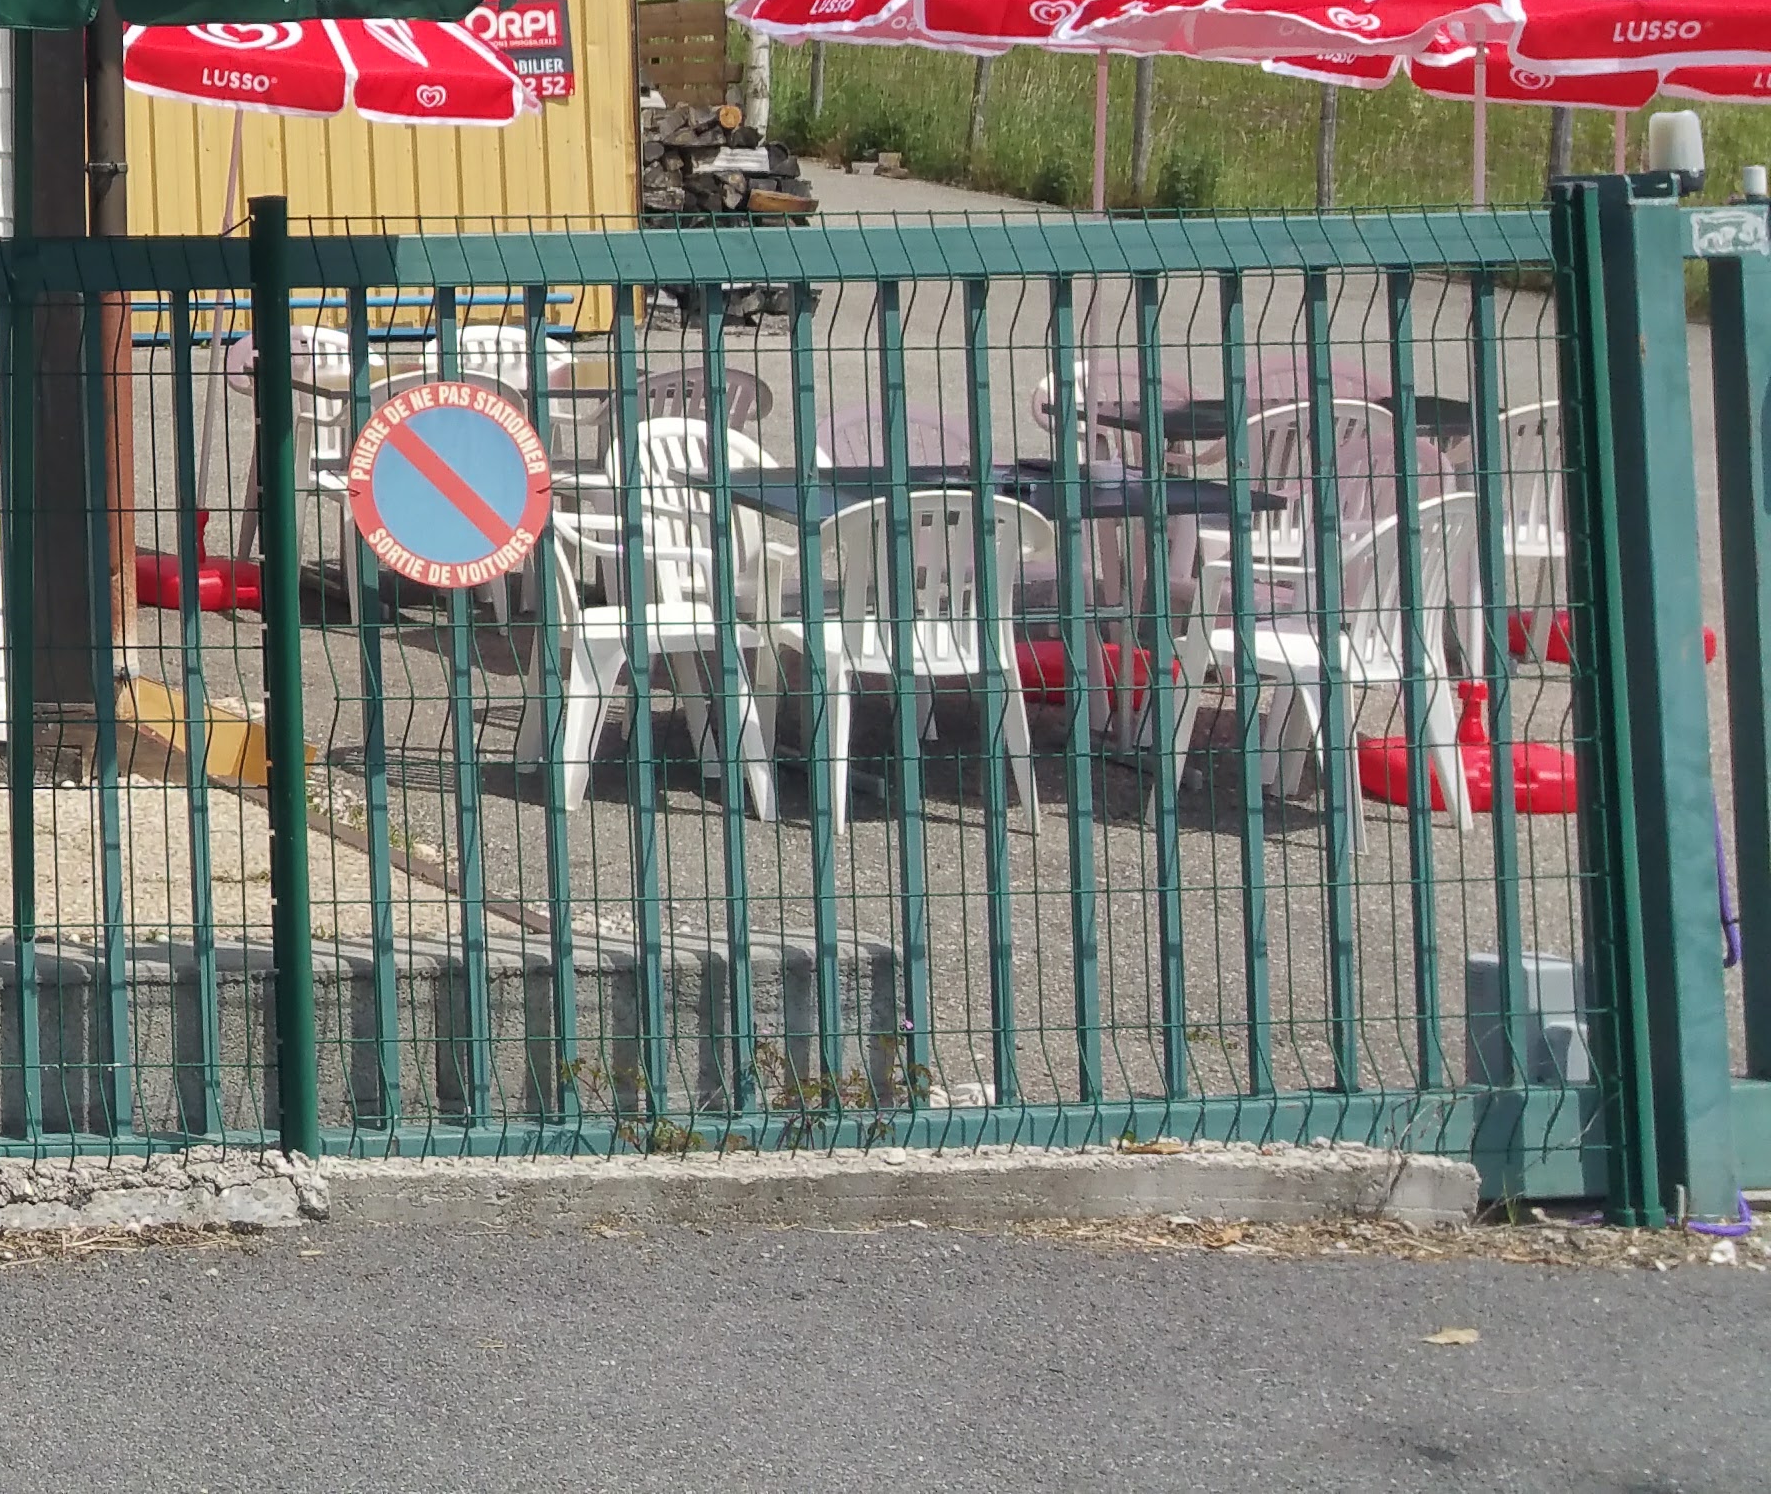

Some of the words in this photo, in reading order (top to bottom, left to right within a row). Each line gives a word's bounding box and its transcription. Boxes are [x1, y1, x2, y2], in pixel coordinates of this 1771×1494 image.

[464, 6, 557, 40] ORPI
[1612, 19, 1702, 43] LUSSO
[513, 58, 565, 75] BILIER
[201, 67, 271, 93] LUSSO
[541, 75, 566, 96] 52
[350, 417, 390, 481] PRIERE
[382, 398, 411, 425] DE
[408, 385, 435, 411] NE
[438, 385, 471, 406] PAS
[473, 391, 547, 475] STATIONNER
[368, 527, 423, 578] SORTIE
[427, 563, 451, 585] DE
[456, 527, 535, 584] VOITURES
